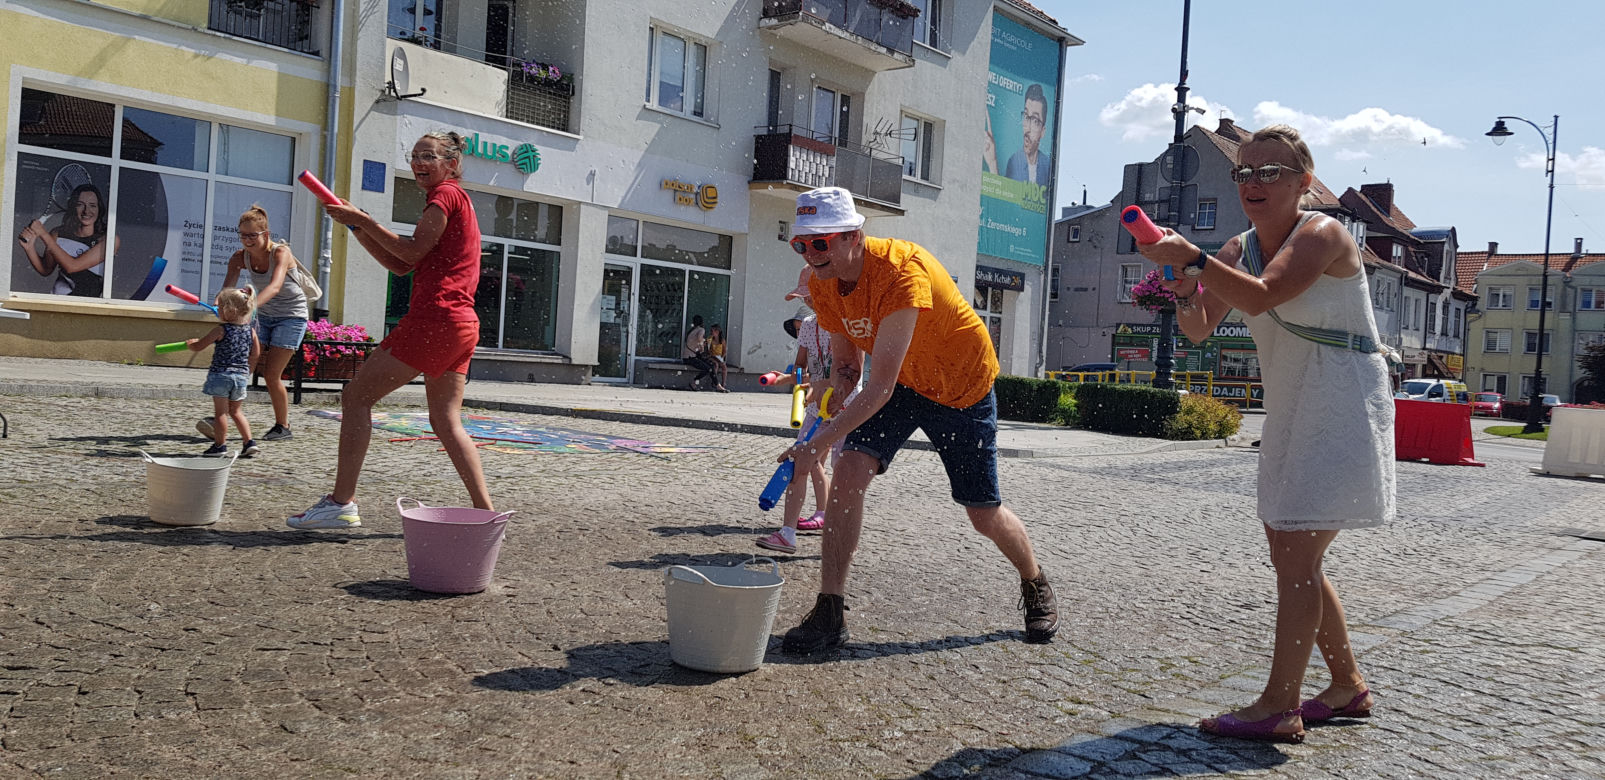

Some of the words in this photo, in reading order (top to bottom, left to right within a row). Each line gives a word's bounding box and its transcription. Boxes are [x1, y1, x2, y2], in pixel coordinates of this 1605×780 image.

[1002, 32, 1033, 51] AGRICOLE
[999, 75, 1023, 93] OFERTY?
[213, 225, 240, 234] zaskak
[987, 217, 1022, 237] Żeromskiego
[1132, 326, 1151, 334] SKUP
[1181, 383, 1259, 398] SPRZDAJEMY
